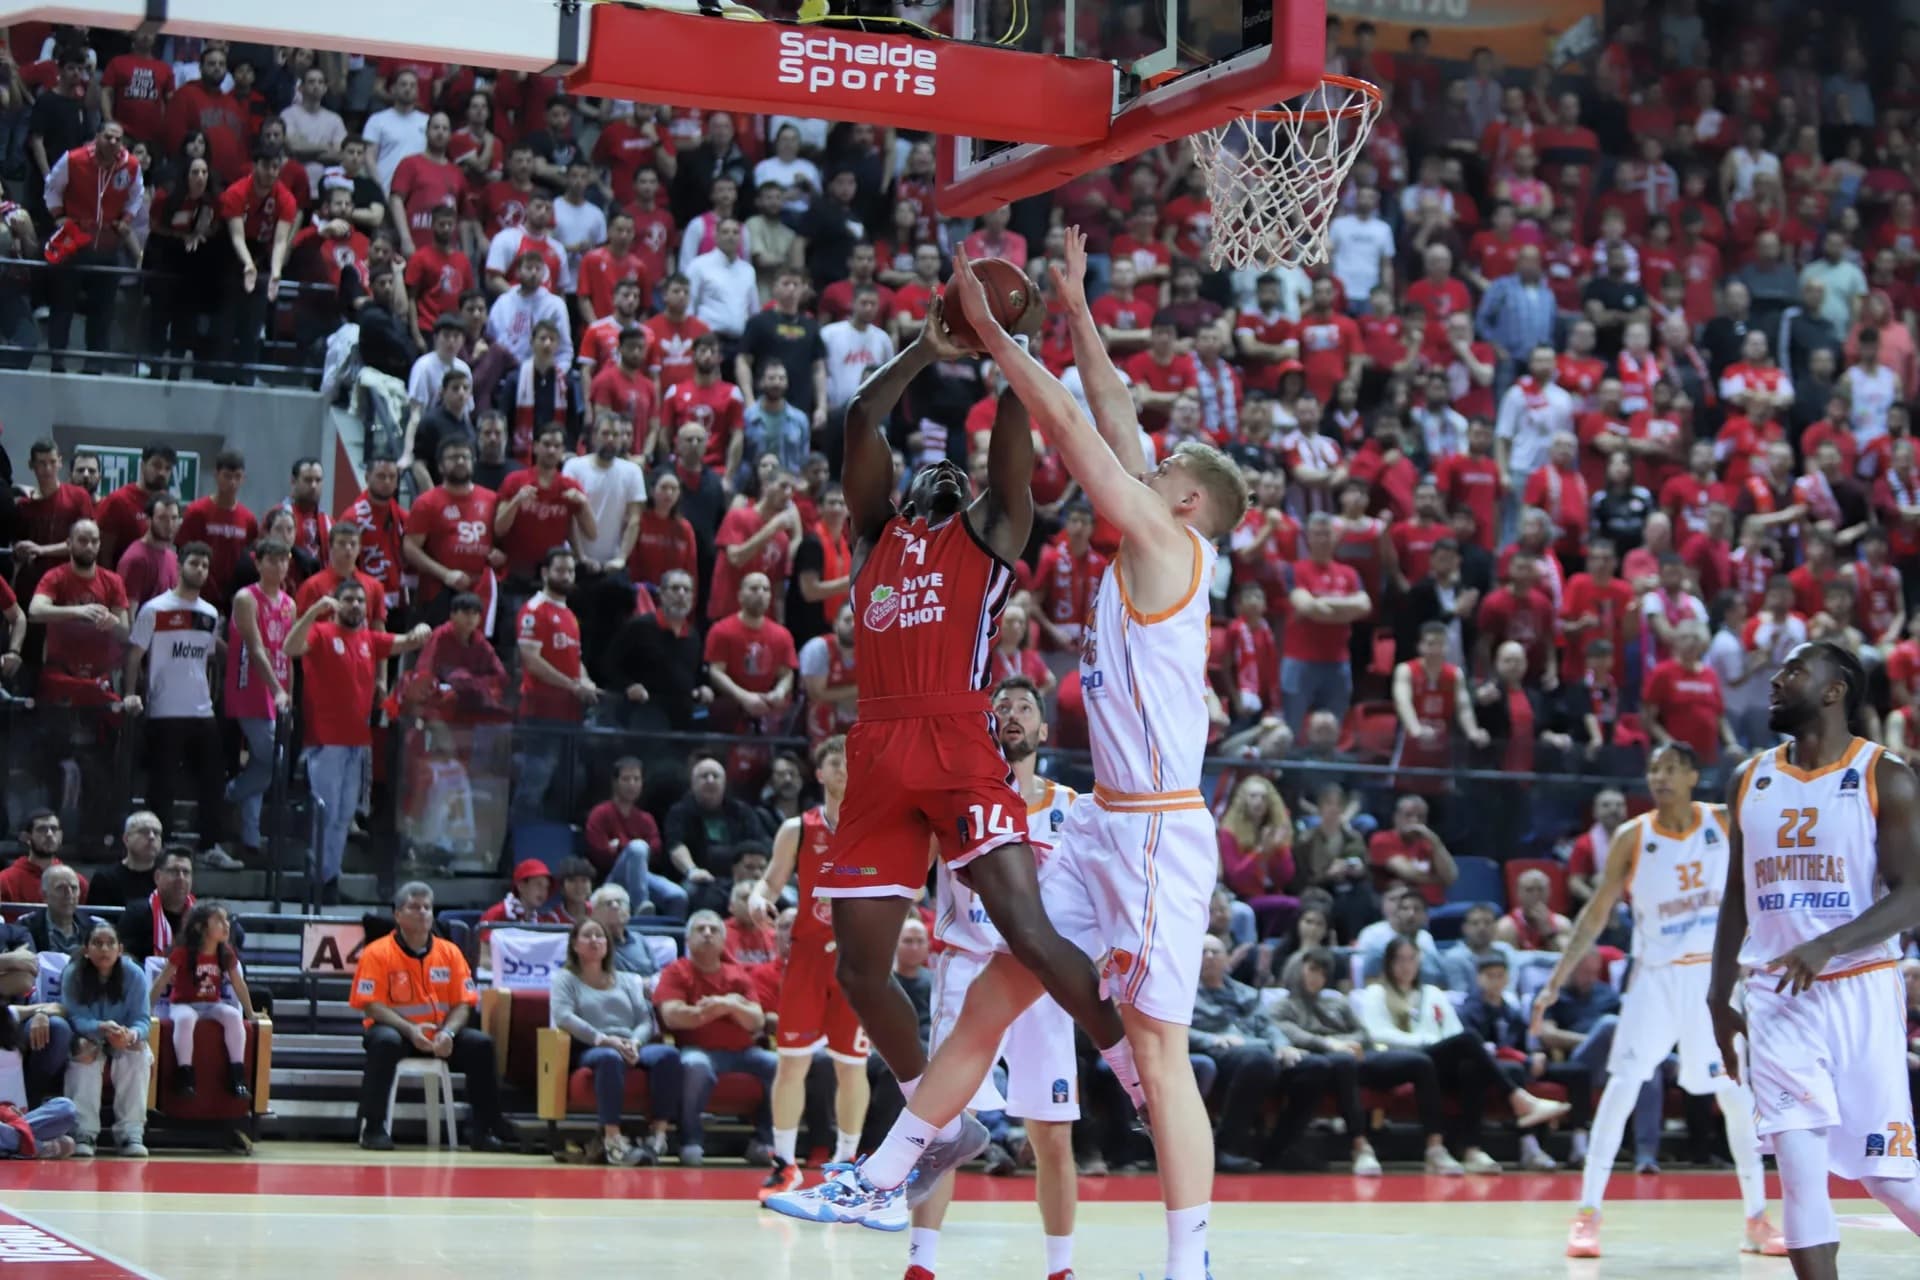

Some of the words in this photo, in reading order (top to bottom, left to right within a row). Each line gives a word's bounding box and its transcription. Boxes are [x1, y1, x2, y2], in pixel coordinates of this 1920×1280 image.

[779, 31, 937, 70] Schelde
[778, 57, 936, 96] Sports
[457, 521, 487, 542] SP
[901, 592, 918, 609] IT
[923, 589, 939, 604] A
[900, 606, 946, 629] SHOT
[969, 804, 1014, 840] 14
[1777, 807, 1819, 849] 22
[1675, 861, 1706, 891] 32
[1789, 891, 1850, 908] FRIGO
